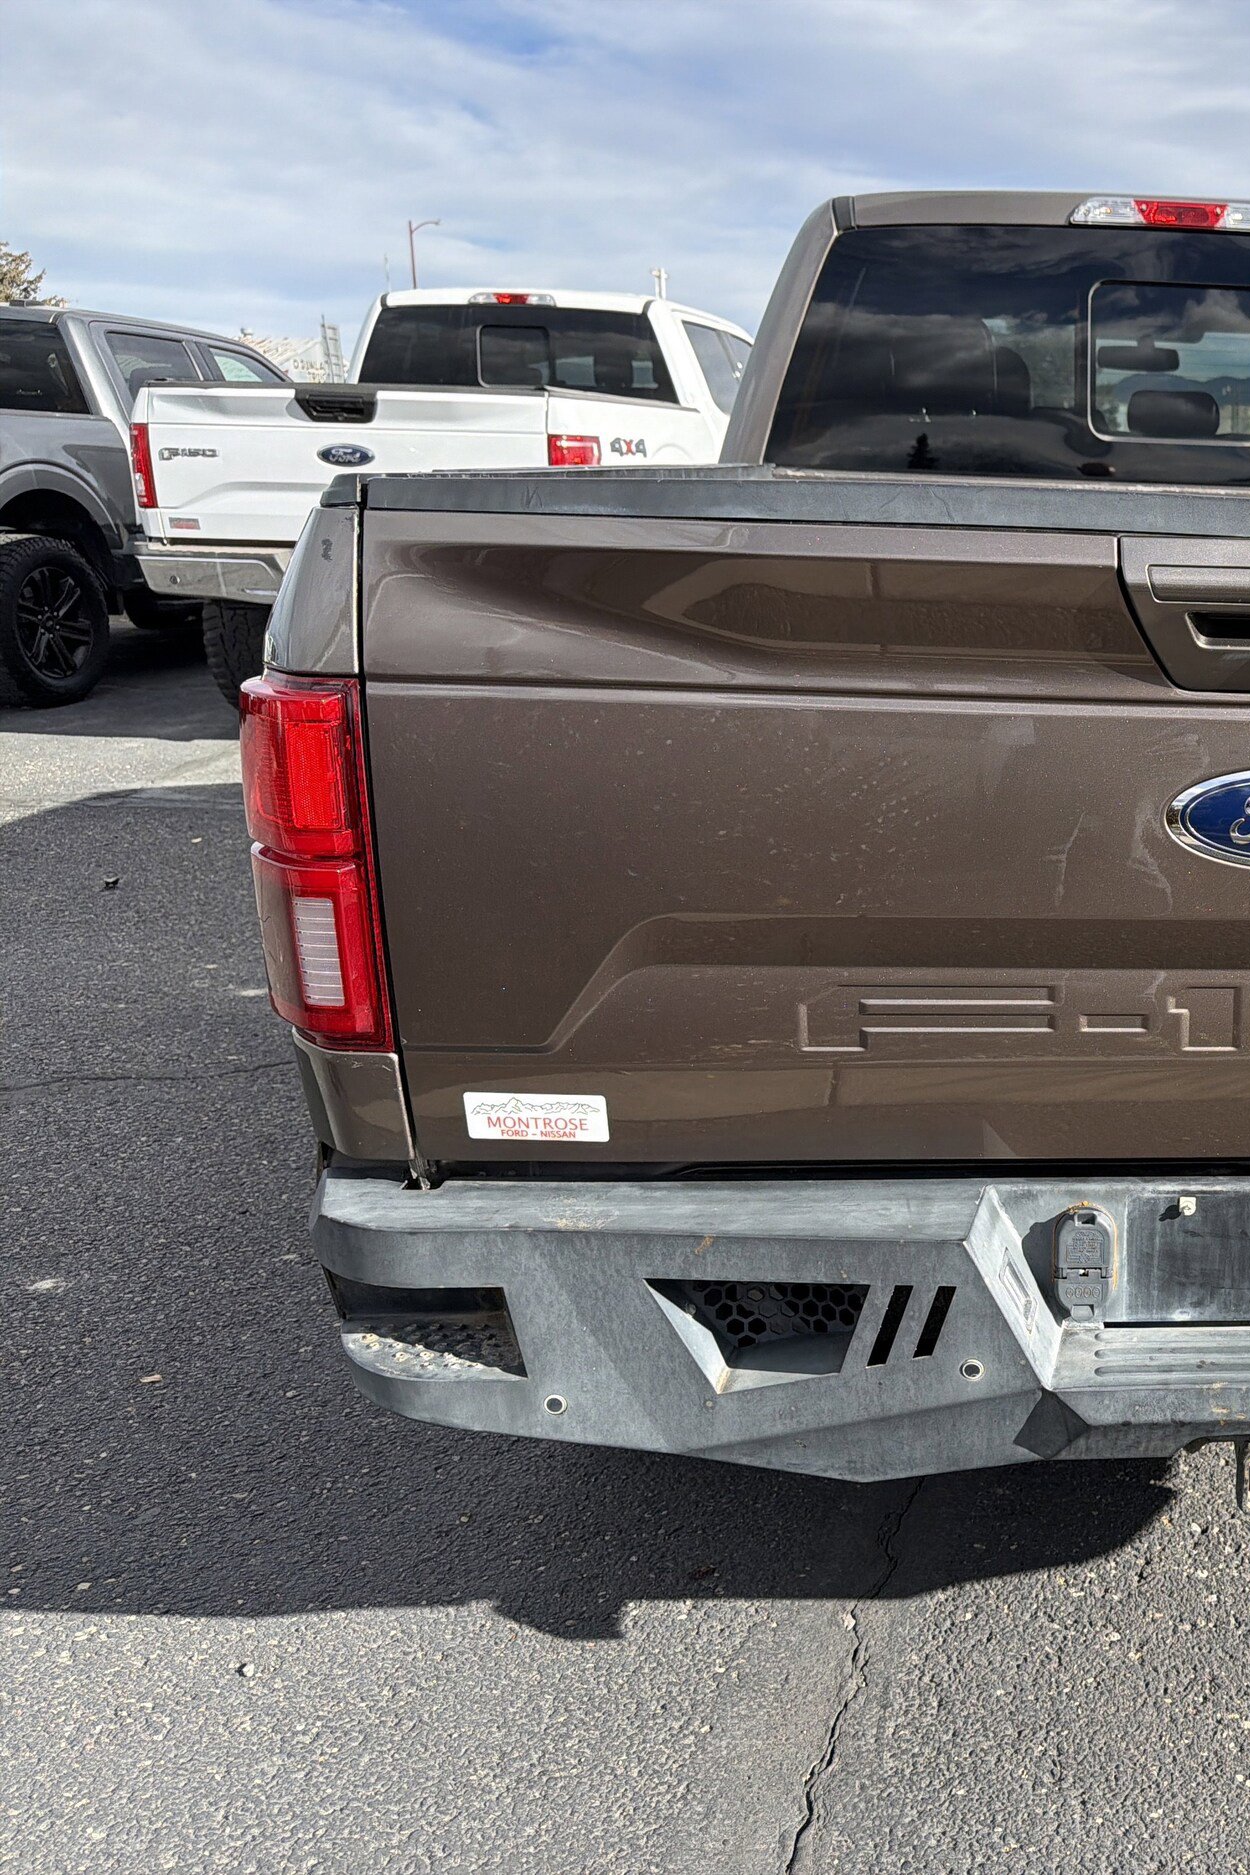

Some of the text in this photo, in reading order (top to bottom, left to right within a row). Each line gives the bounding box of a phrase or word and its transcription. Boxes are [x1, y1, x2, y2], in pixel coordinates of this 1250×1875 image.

[329, 447, 361, 463] Ford
[487, 1116, 590, 1131] MONTROSE
[501, 1129, 529, 1138] FORD
[540, 1130, 576, 1138] NISSAN
